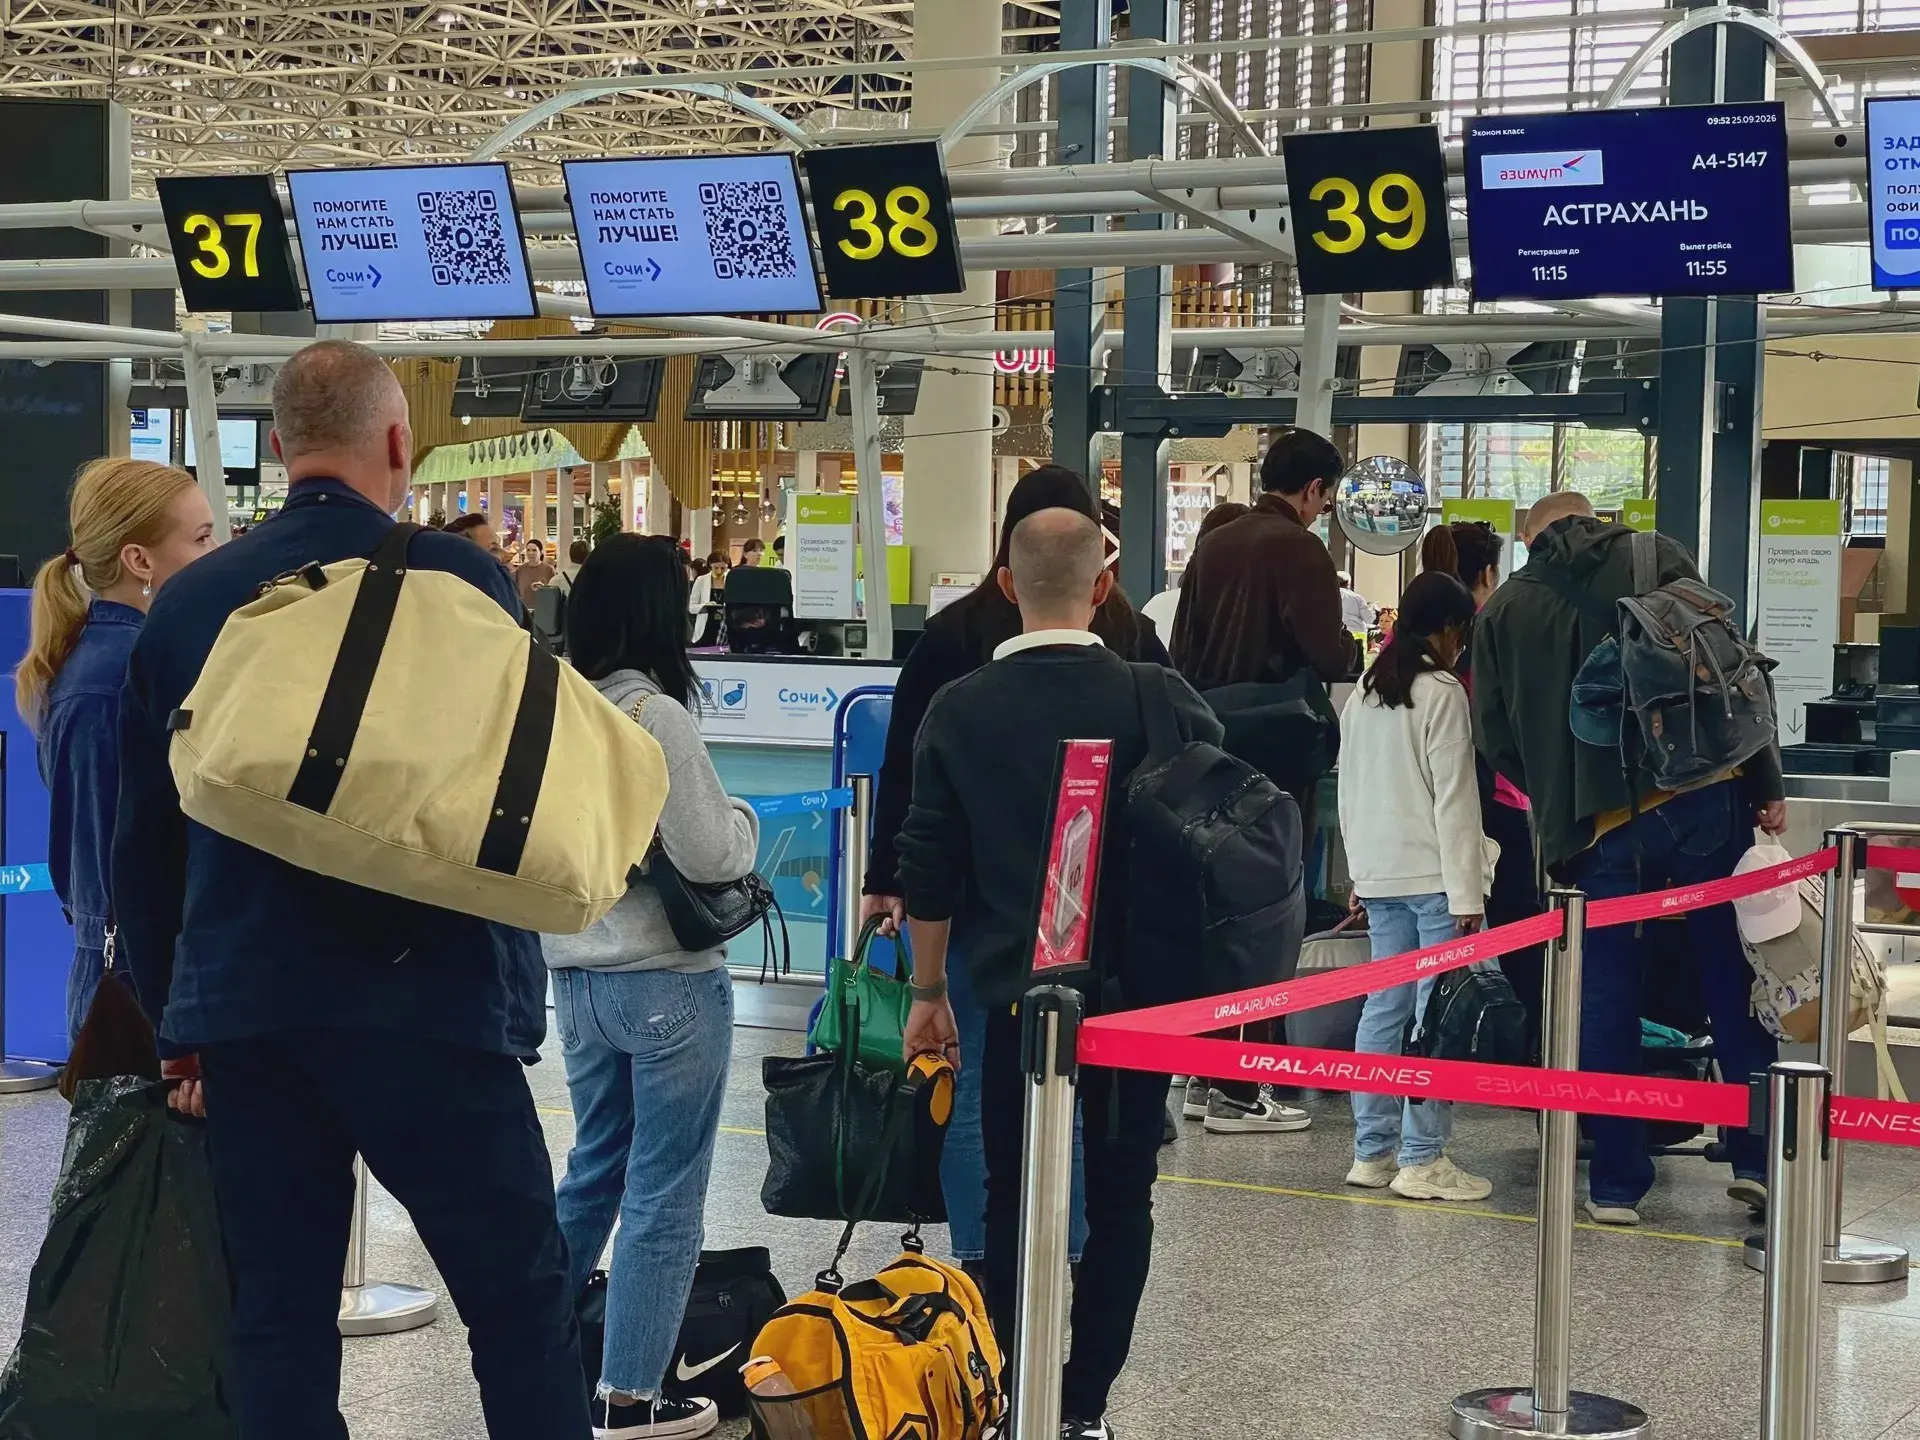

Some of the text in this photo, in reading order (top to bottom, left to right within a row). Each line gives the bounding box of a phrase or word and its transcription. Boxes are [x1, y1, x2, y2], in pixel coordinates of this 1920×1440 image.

[1708, 114, 1776, 125] 09:52 25.09.2026
[1472, 129, 1500, 137] Эконом
[1692, 152, 1768, 170] A4-5147
[1500, 168, 1563, 181] азимут
[590, 190, 668, 204] ПОМОГИТЕ
[1887, 184, 1920, 195] ПОЛ
[313, 199, 388, 212] ПОМОГИТЕ
[594, 206, 675, 221] НАМ СТАТЬ
[1309, 173, 1426, 254] 39
[1543, 200, 1708, 226] АСТРАХАНЬ
[317, 215, 394, 229] НАМ СТАТЬ
[833, 185, 938, 260] 38
[321, 232, 399, 251] ЛУЧШЕ!
[599, 225, 679, 244] ЛУЧШЕ!
[1891, 227, 1920, 242] ПО
[183, 213, 262, 279] 37
[1518, 248, 1569, 256] Регистрация
[1680, 242, 1732, 251] Вылет рейса
[326, 267, 364, 284] Сочи
[604, 261, 643, 277] Сочи
[1532, 266, 1568, 281] 11:15
[1686, 260, 1727, 276] 11:55
[1768, 548, 1808, 556] Проверьте
[778, 688, 819, 704] Сочи
[0, 869, 14, 885] hi
[1416, 943, 1475, 971] URAL AIRLINES
[1214, 991, 1289, 1019] URAL AIRLINES
[1239, 1054, 1433, 1086] URAL AIRLINES
